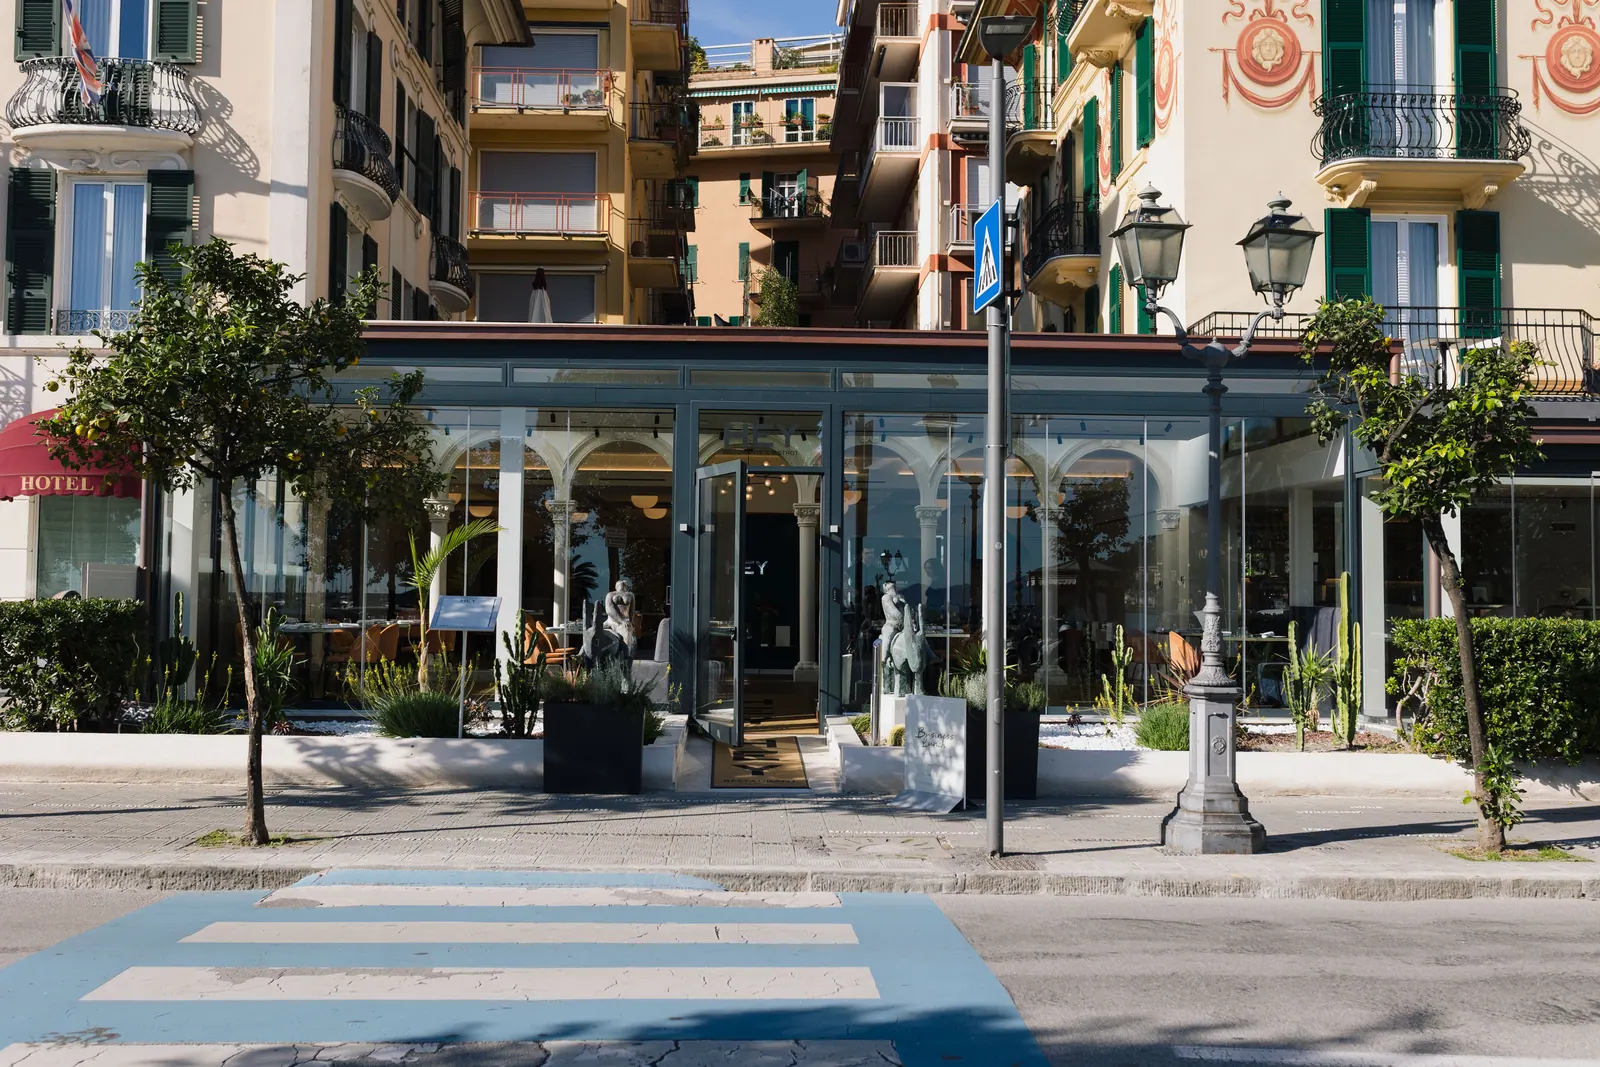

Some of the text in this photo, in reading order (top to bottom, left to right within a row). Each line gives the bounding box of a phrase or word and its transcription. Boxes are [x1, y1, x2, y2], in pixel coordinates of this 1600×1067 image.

[723, 423, 798, 447] HEY
[21, 475, 94, 491] HOTEL
[915, 727, 954, 741] Business
[921, 738, 946, 749] Lunch
